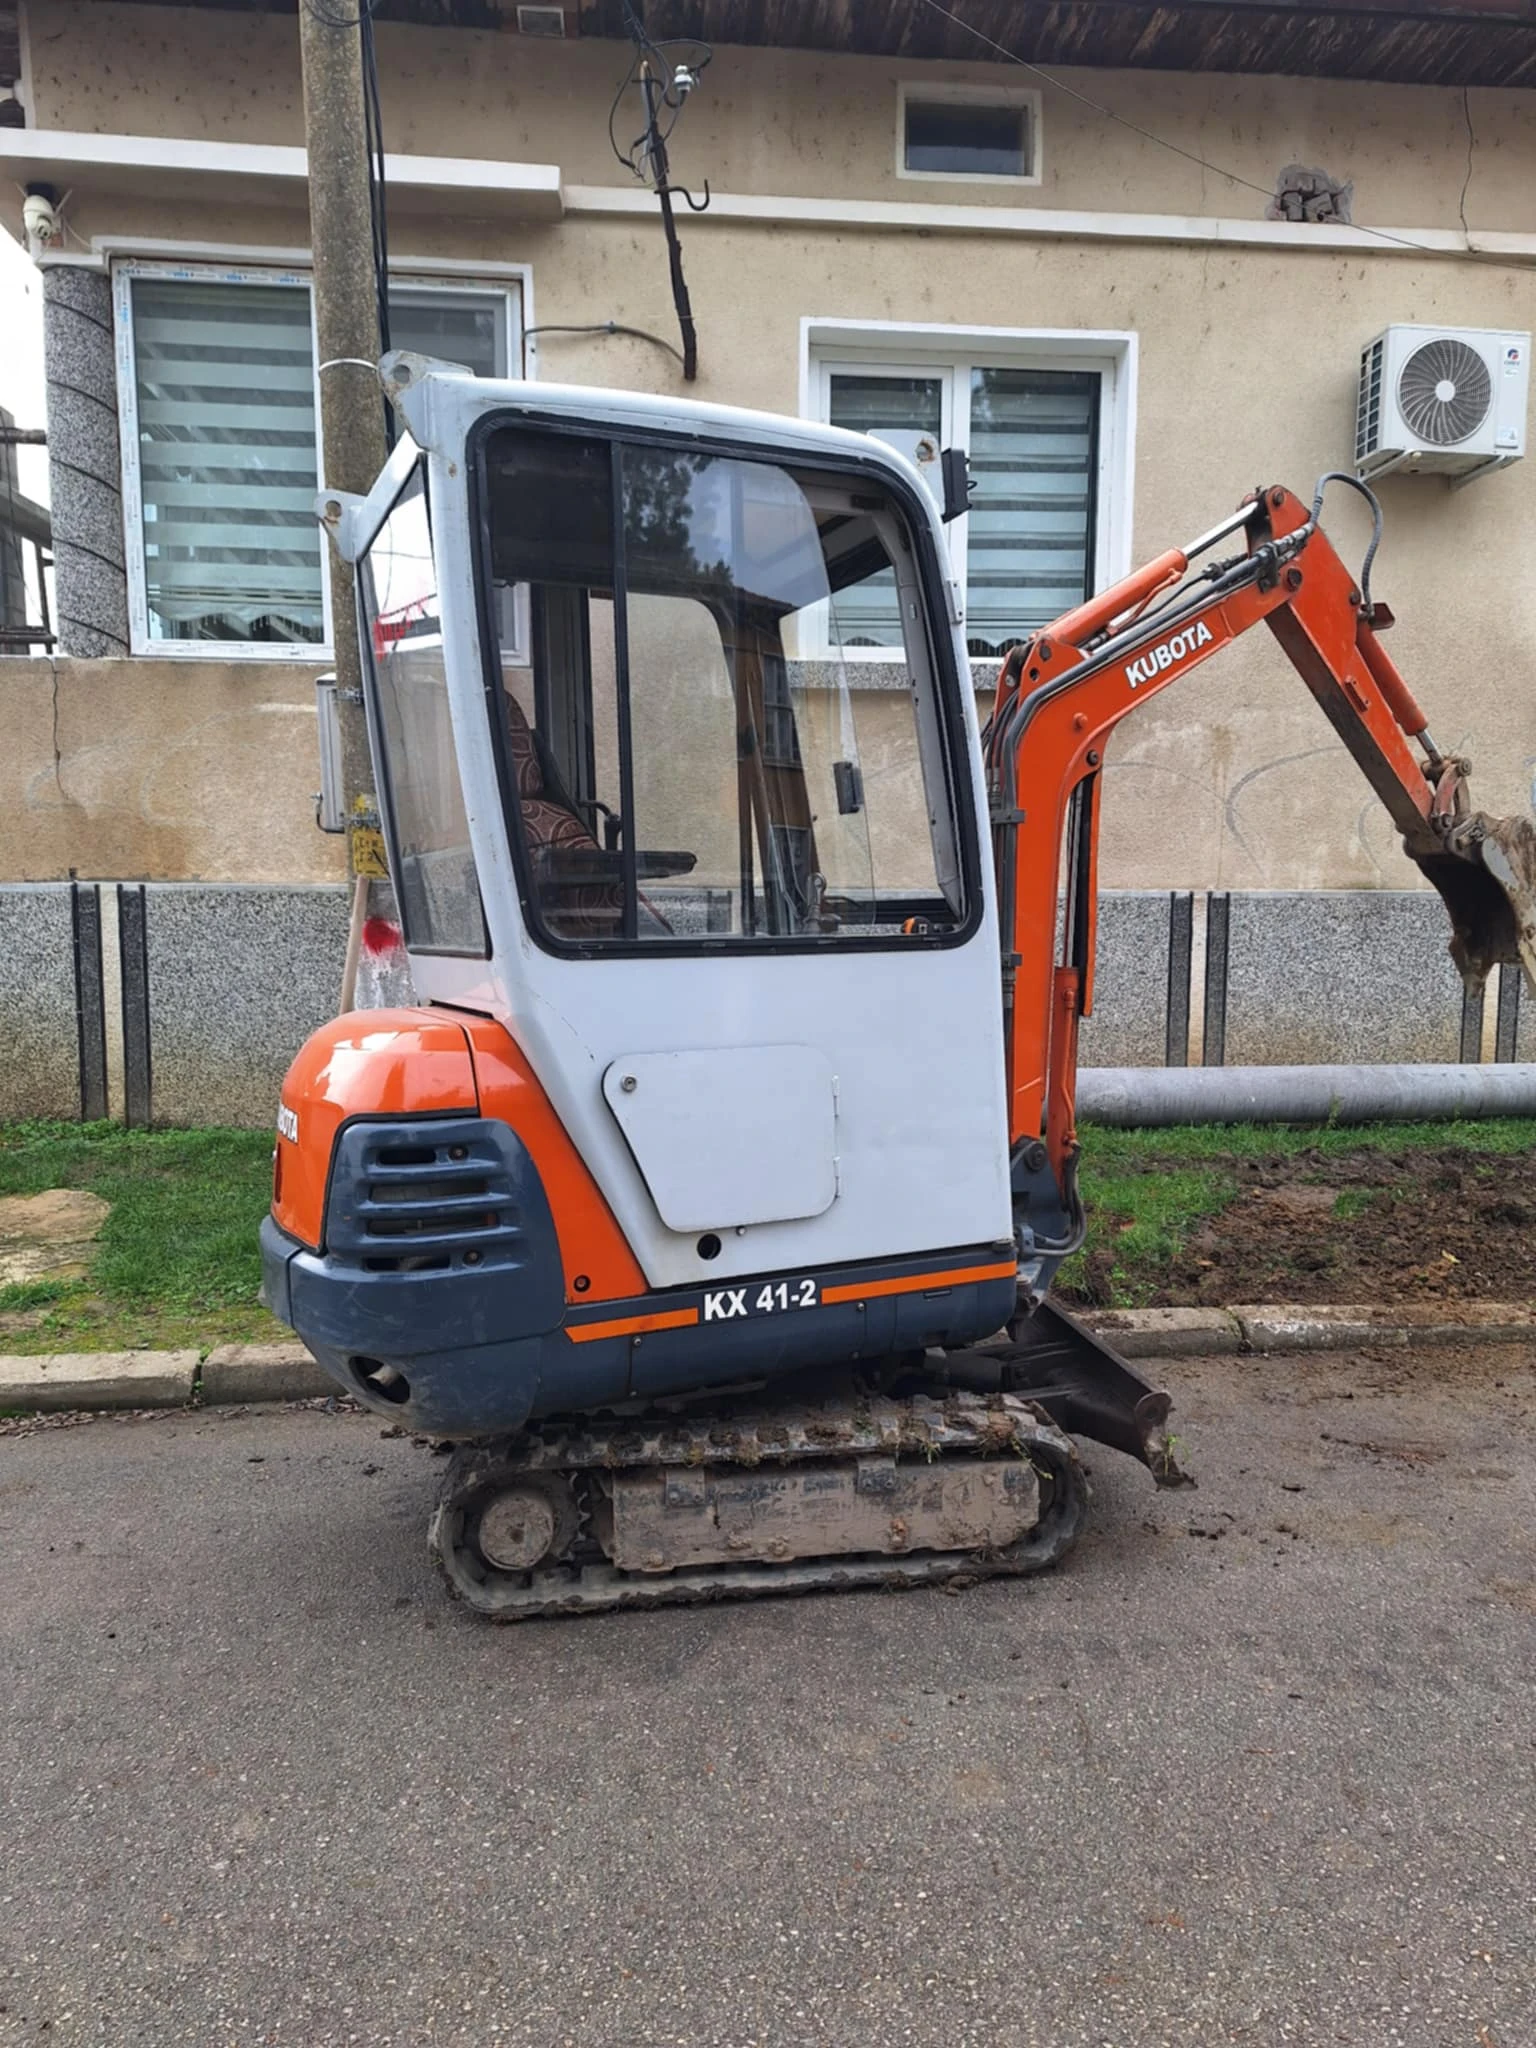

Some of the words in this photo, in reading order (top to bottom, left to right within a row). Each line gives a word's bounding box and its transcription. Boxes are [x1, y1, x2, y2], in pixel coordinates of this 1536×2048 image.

[1125, 621, 1213, 689] KUBOTA
[704, 1288, 748, 1321] KX
[756, 1279, 817, 1312] 41-2
